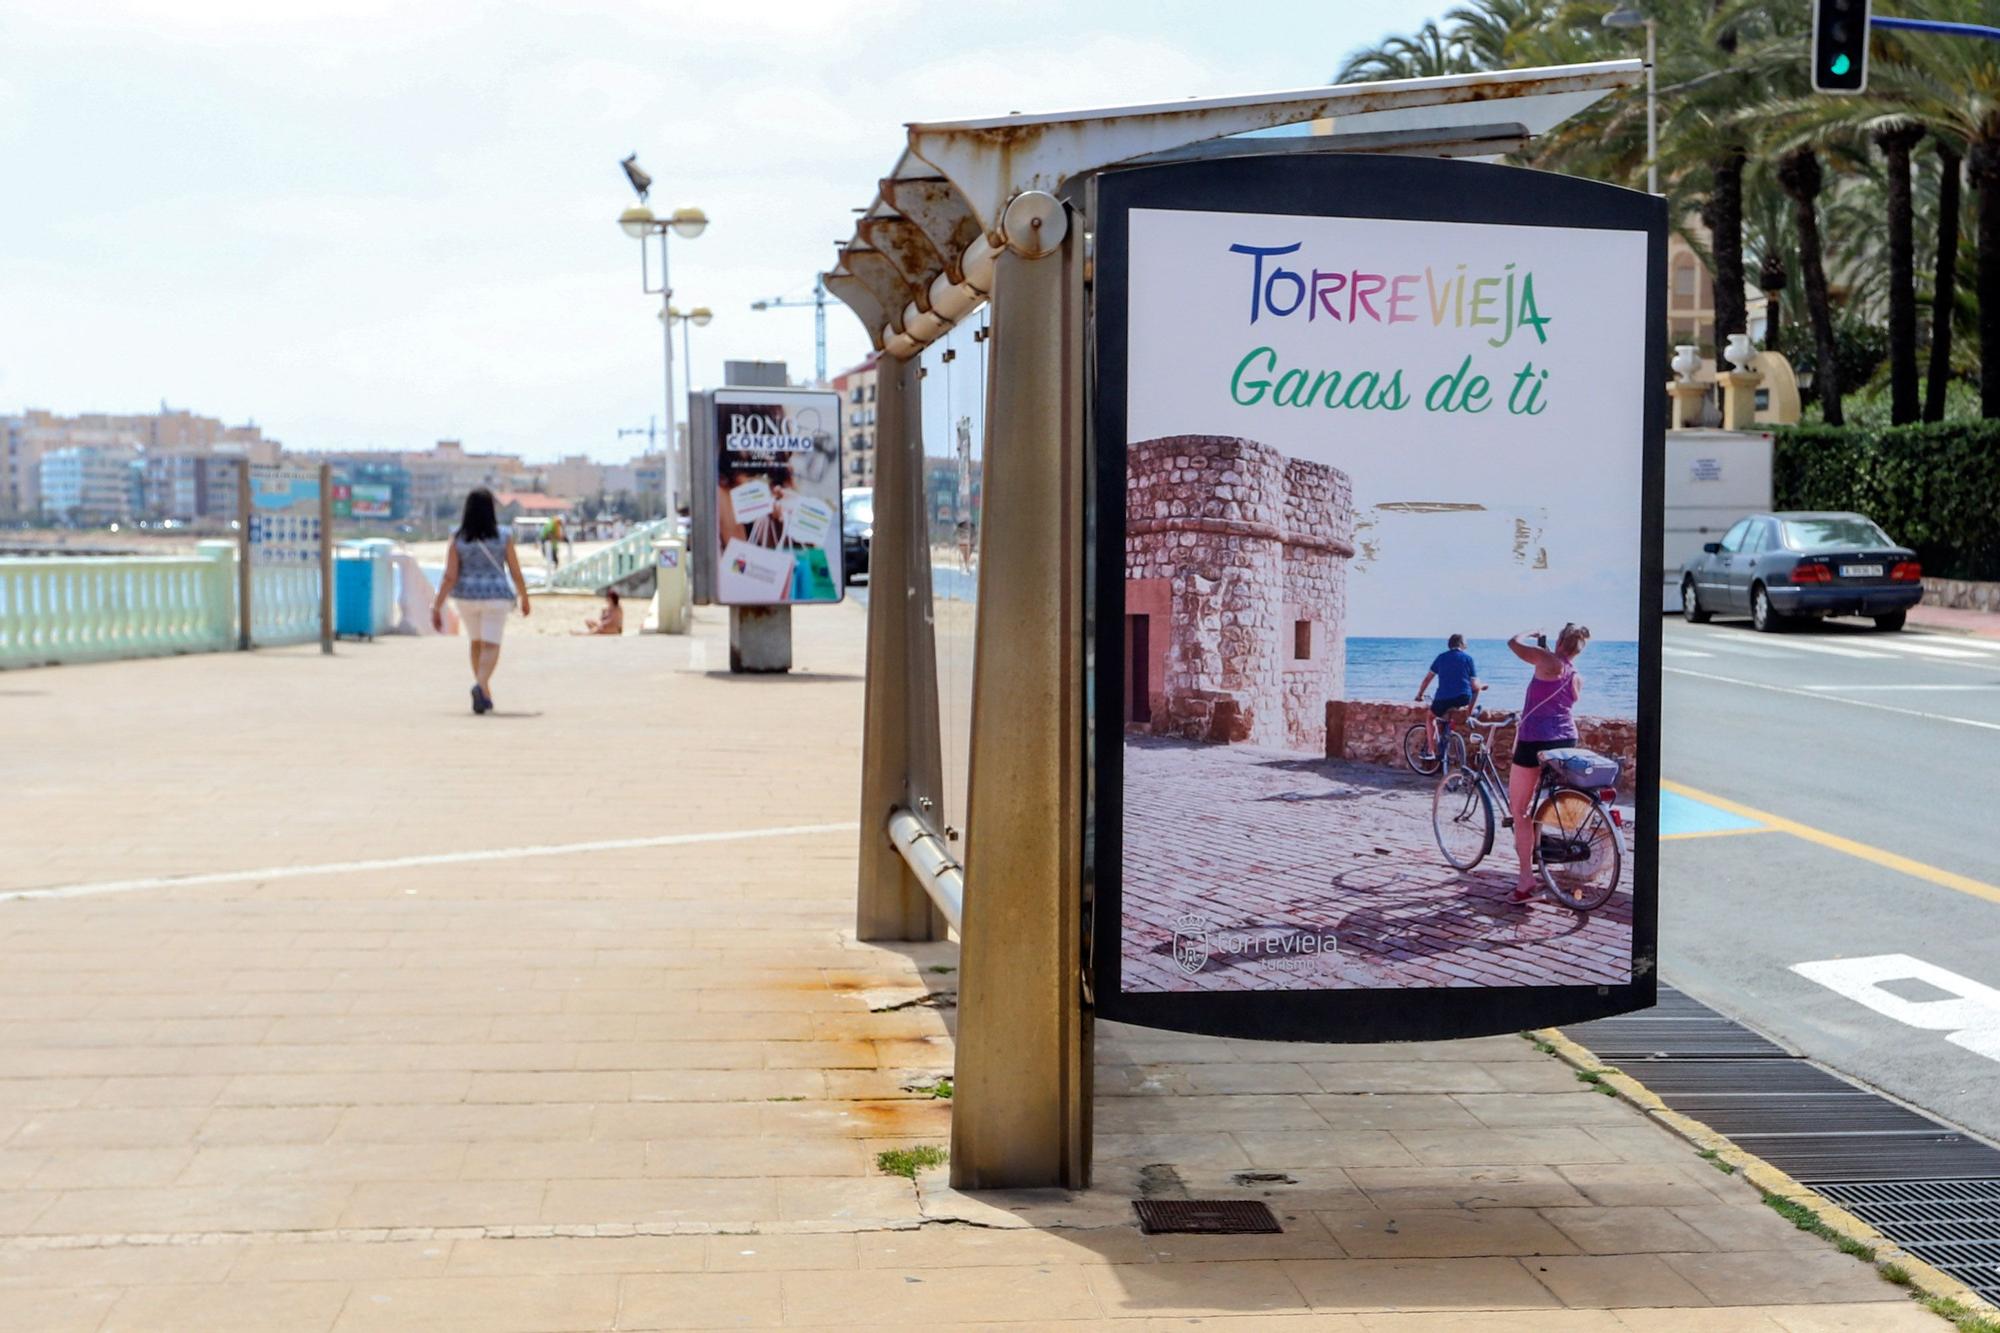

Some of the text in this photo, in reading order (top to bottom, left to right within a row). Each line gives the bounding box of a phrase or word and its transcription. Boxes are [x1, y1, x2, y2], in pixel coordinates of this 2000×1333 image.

[1231, 346, 1549, 415] Ganas de ti
[730, 414, 798, 436] BONO
[729, 436, 812, 449] CONSUMO
[1218, 929, 1338, 958] torrevieja
[1261, 956, 1316, 972] turismo
